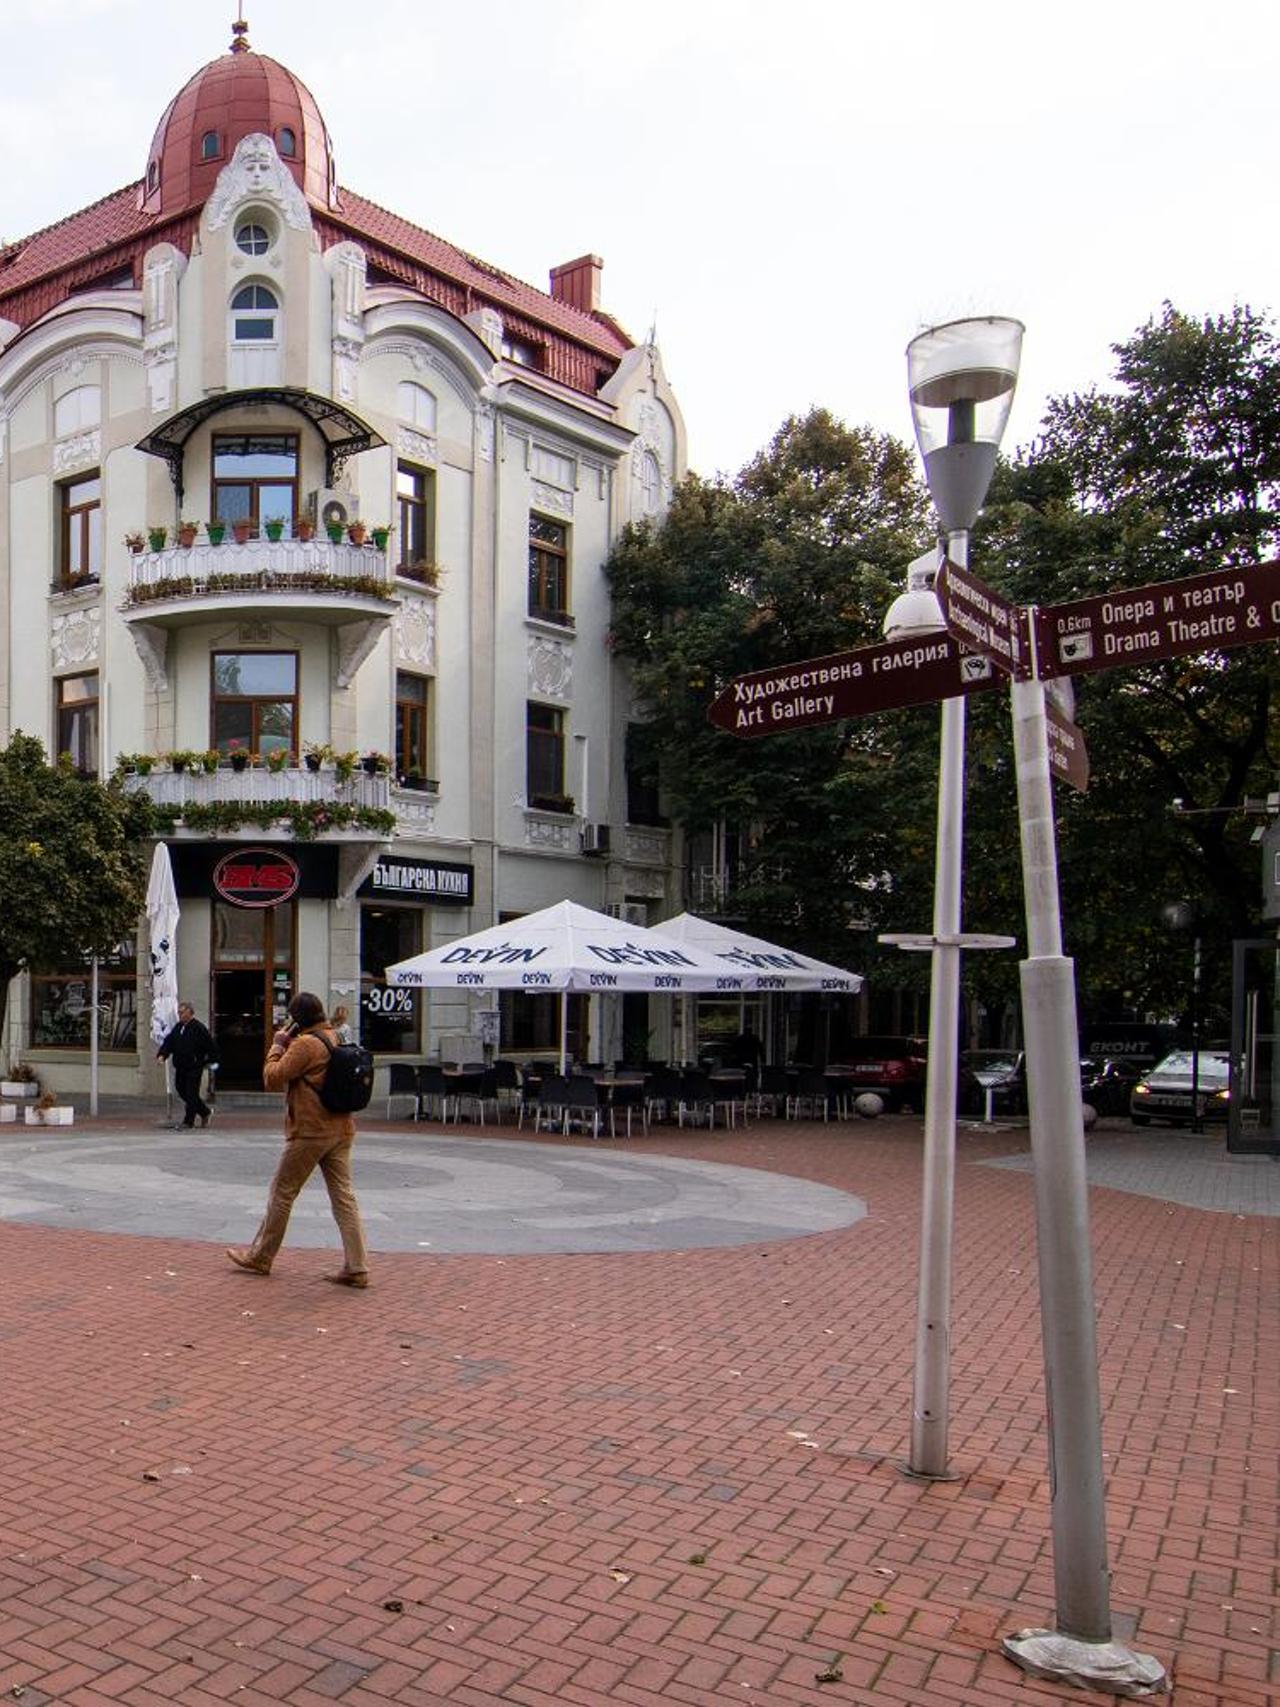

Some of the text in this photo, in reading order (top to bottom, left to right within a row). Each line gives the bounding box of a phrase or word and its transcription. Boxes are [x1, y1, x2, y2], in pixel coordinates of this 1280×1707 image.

[1102, 581, 1245, 624] Опера и театър
[1104, 630, 1160, 655] Drama
[1167, 614, 1236, 642] Theatre
[1246, 606, 1261, 627] &
[734, 642, 948, 704] Художествена галерия
[736, 695, 834, 729] Art Gallery
[440, 942, 548, 964] DEVIN
[586, 942, 698, 967] DEVIN
[457, 971, 484, 984] DEVIN
[521, 971, 552, 984] DEVIN
[590, 973, 617, 986] DEVIN
[655, 974, 681, 987] DEVIN
[756, 976, 786, 989] DEVIN
[362, 988, 413, 1011] -30%
